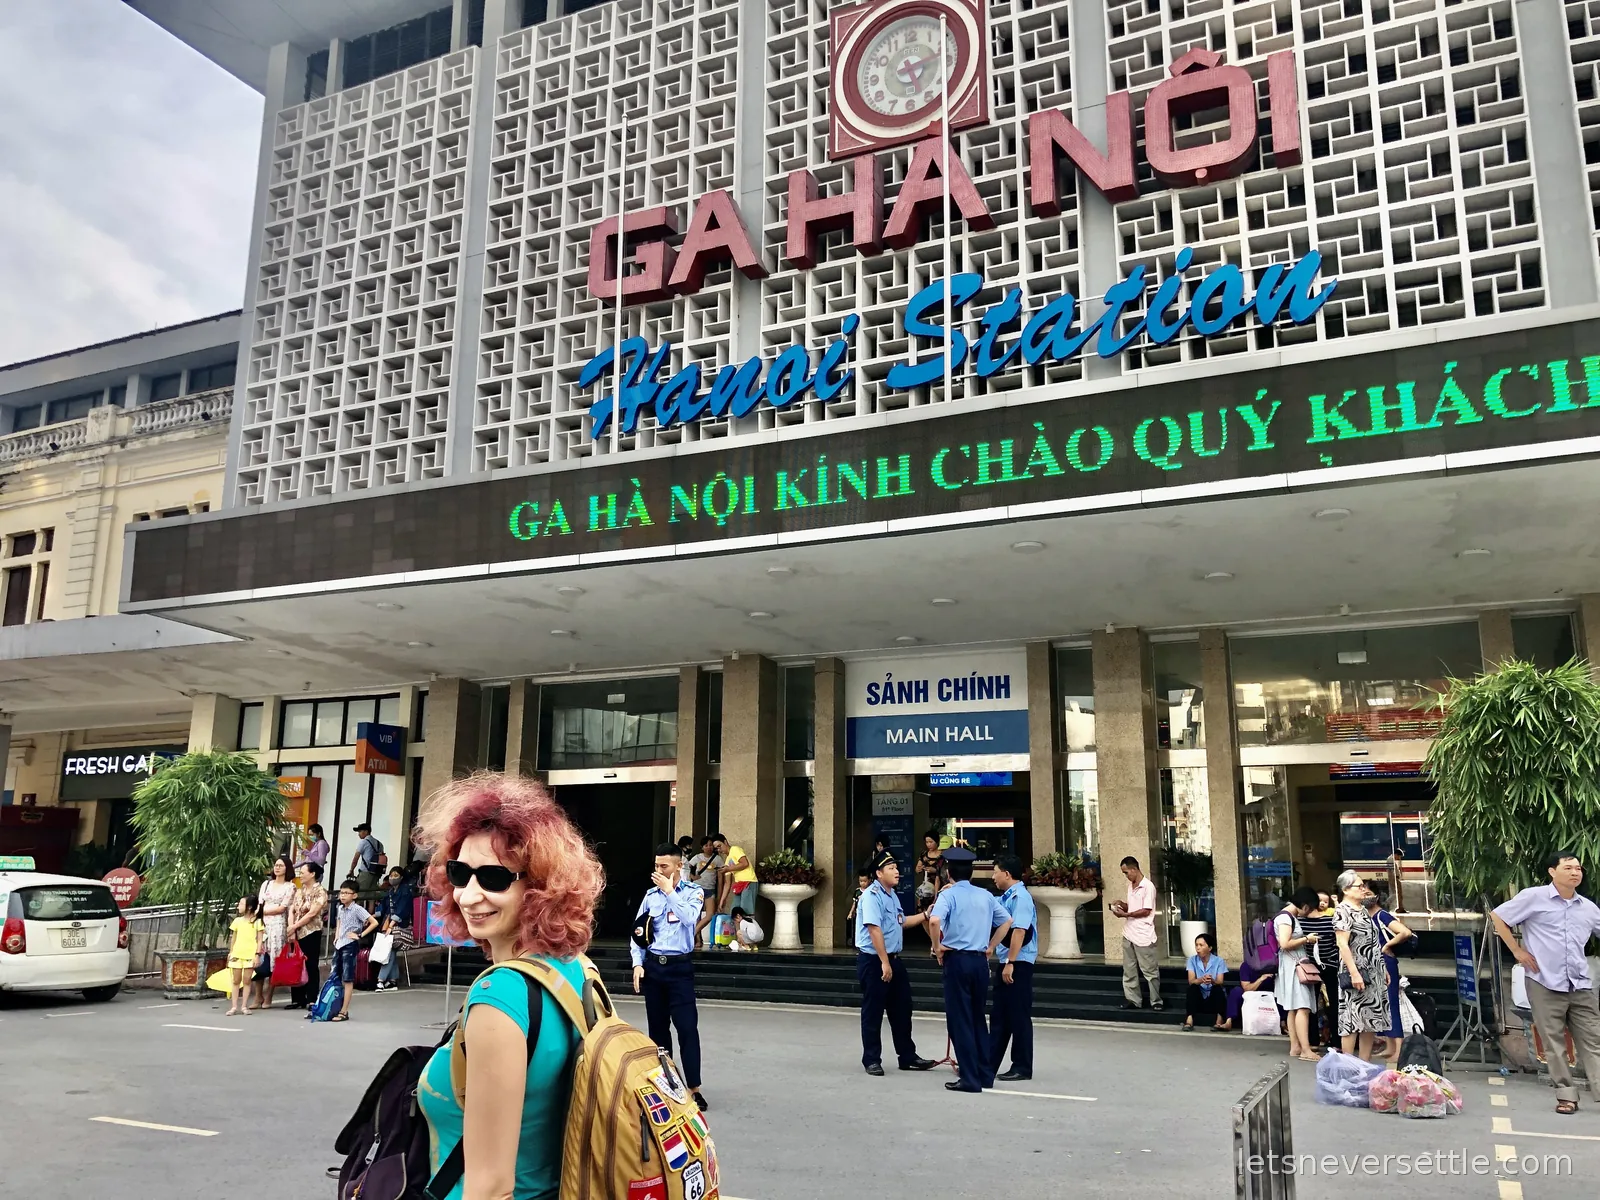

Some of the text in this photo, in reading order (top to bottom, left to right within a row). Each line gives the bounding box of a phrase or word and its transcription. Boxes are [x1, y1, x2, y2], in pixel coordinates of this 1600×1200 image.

[904, 30, 917, 44] 12
[876, 55, 889, 69] 10
[870, 74, 879, 86] 9
[874, 90, 885, 103] 8
[888, 99, 898, 113] 7
[905, 99, 916, 112] 6
[588, 47, 1302, 305] GA HÀ NỘI
[579, 246, 1338, 440] Hanoi Station
[508, 498, 575, 541] GA
[586, 478, 656, 532] HÀ
[668, 471, 761, 526] NỘI
[774, 454, 916, 511] KÍNH
[930, 422, 1115, 490] CHÀO
[1132, 388, 1282, 471] QUÝ
[866, 670, 1011, 706] SẢNH CHÍNH
[379, 734, 393, 744] VIB
[886, 725, 994, 744] MAIN HALL
[65, 756, 119, 775] FRESH
[367, 758, 387, 770] ATM
[900, 797, 909, 805] 01
[67, 929, 80, 938] 30E
[685, 1164, 701, 1177] ARIZONA
[690, 1181, 702, 1200] 66
